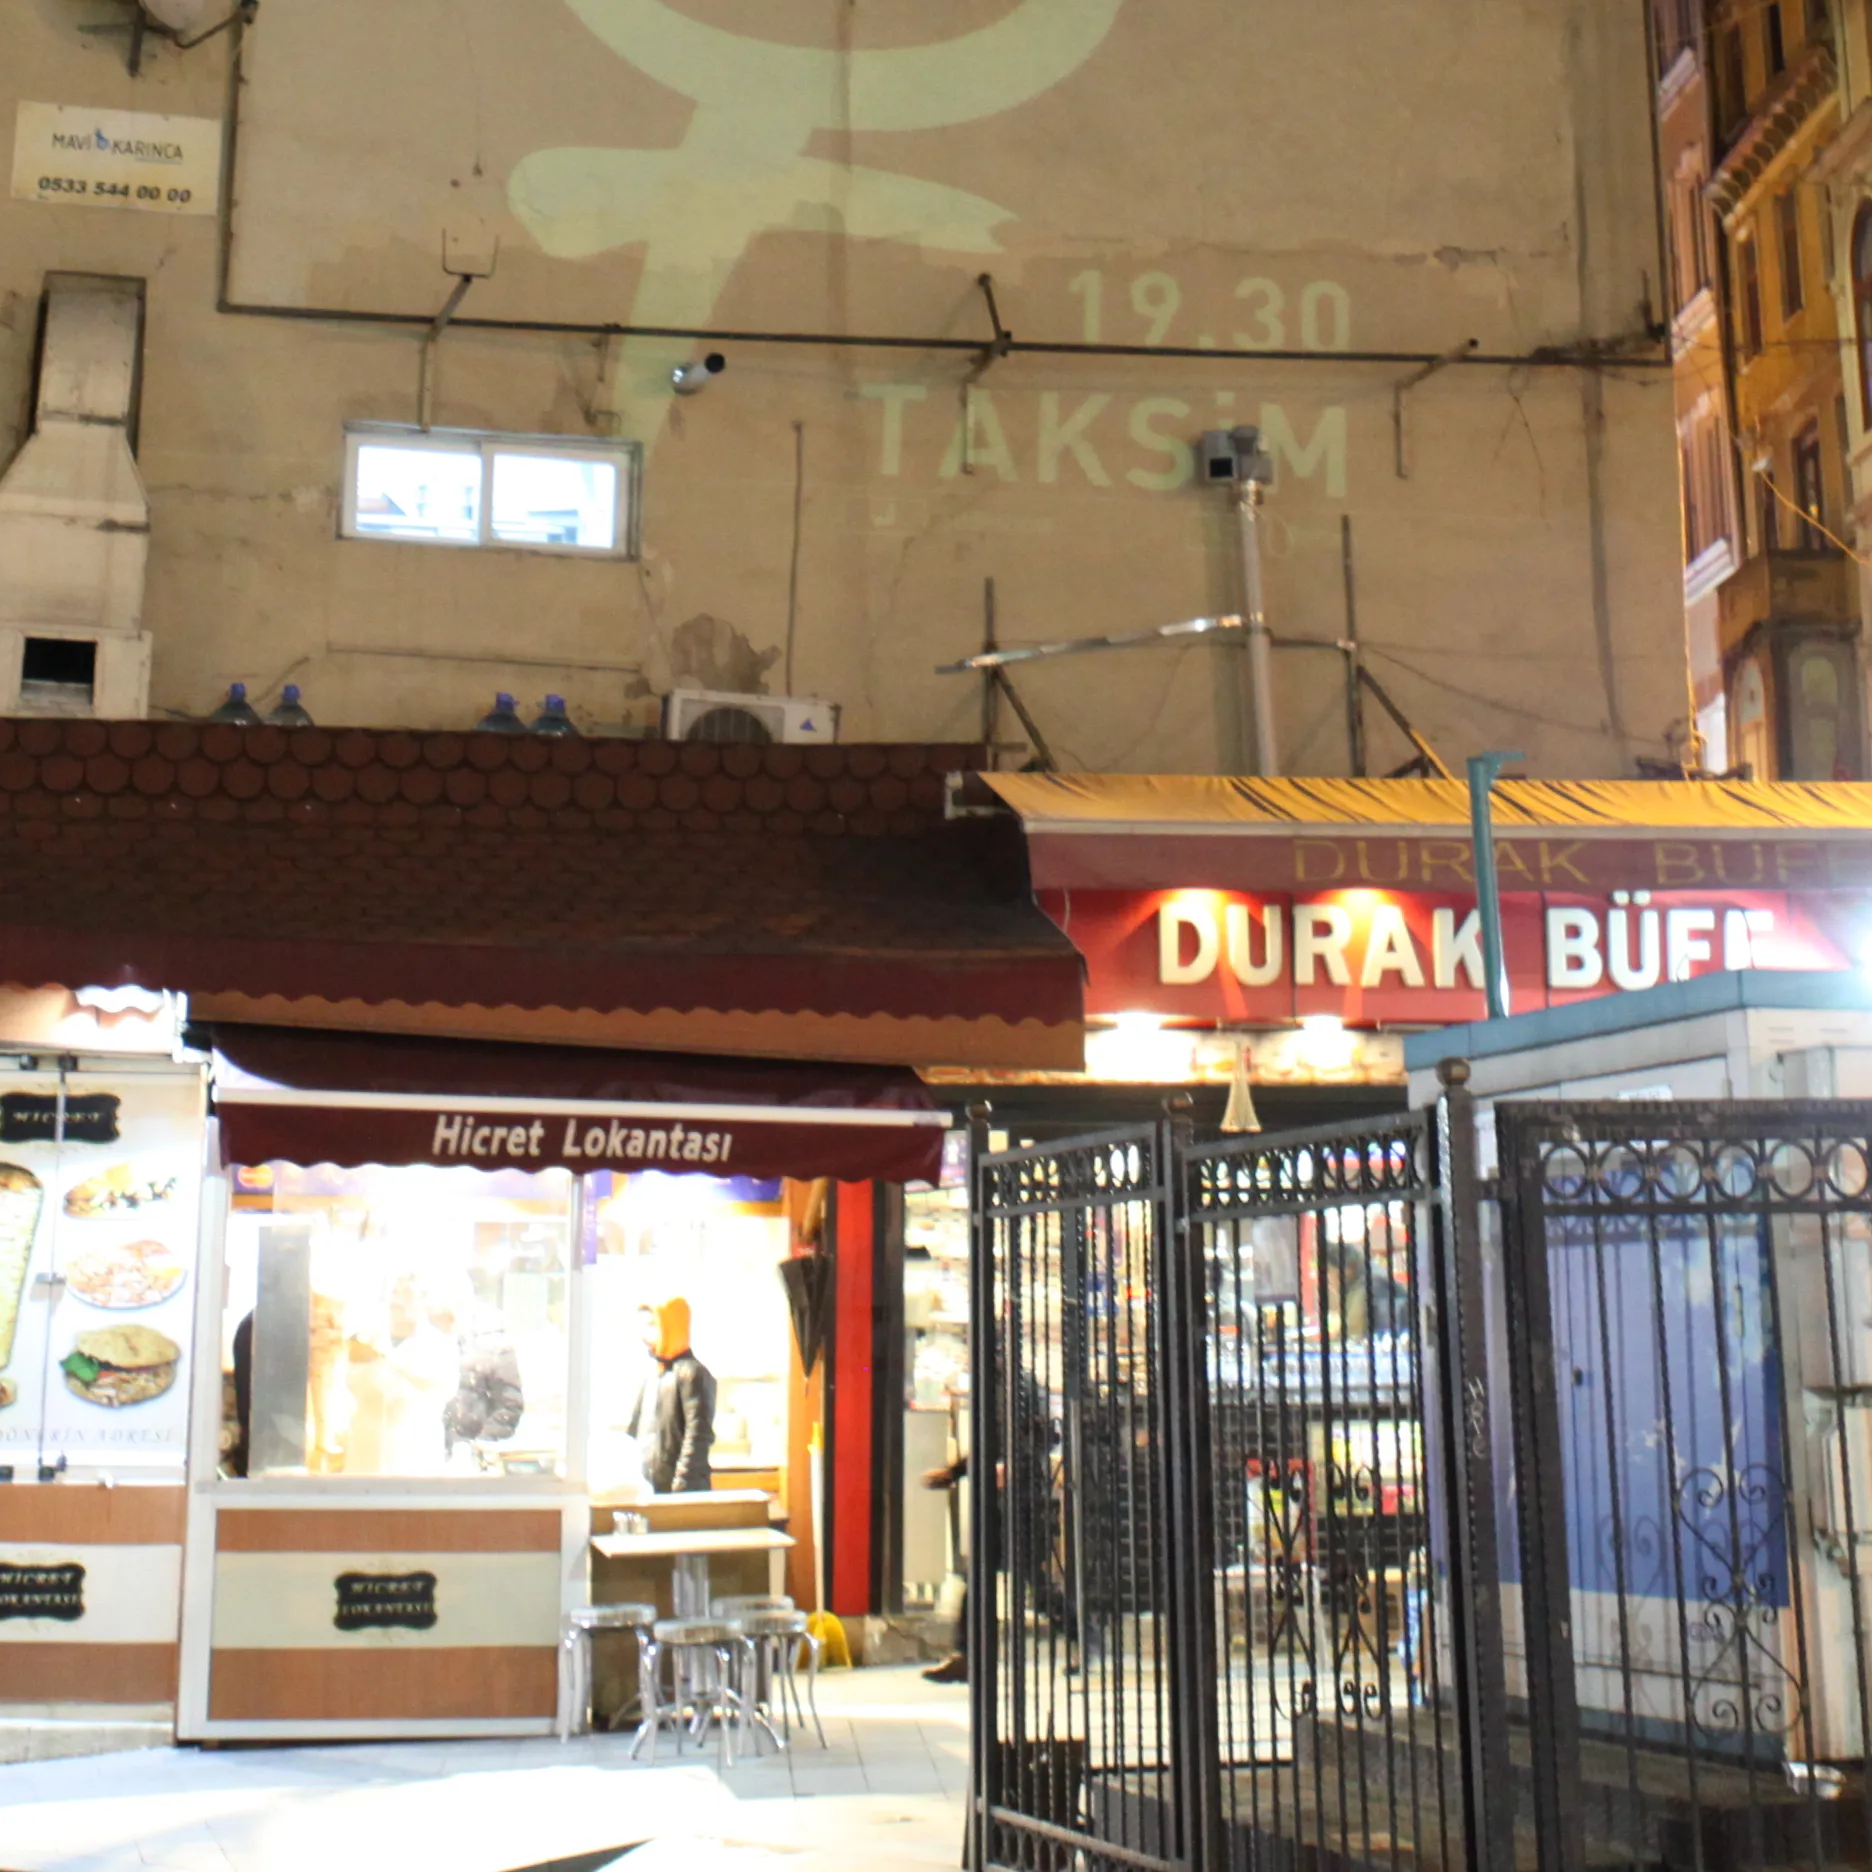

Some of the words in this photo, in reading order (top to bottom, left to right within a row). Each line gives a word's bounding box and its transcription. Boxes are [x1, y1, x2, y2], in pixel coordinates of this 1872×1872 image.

[38, 176, 86, 195] 0533
[93, 181, 129, 197] 544
[136, 184, 160, 201] 00
[167, 188, 191, 204] 00
[1069, 268, 1350, 354] 19.30
[1292, 838, 1592, 886] DURAK
[1159, 903, 1489, 991] DURAK
[432, 1114, 545, 1158] Hicret
[562, 1117, 733, 1163] Lokantası
